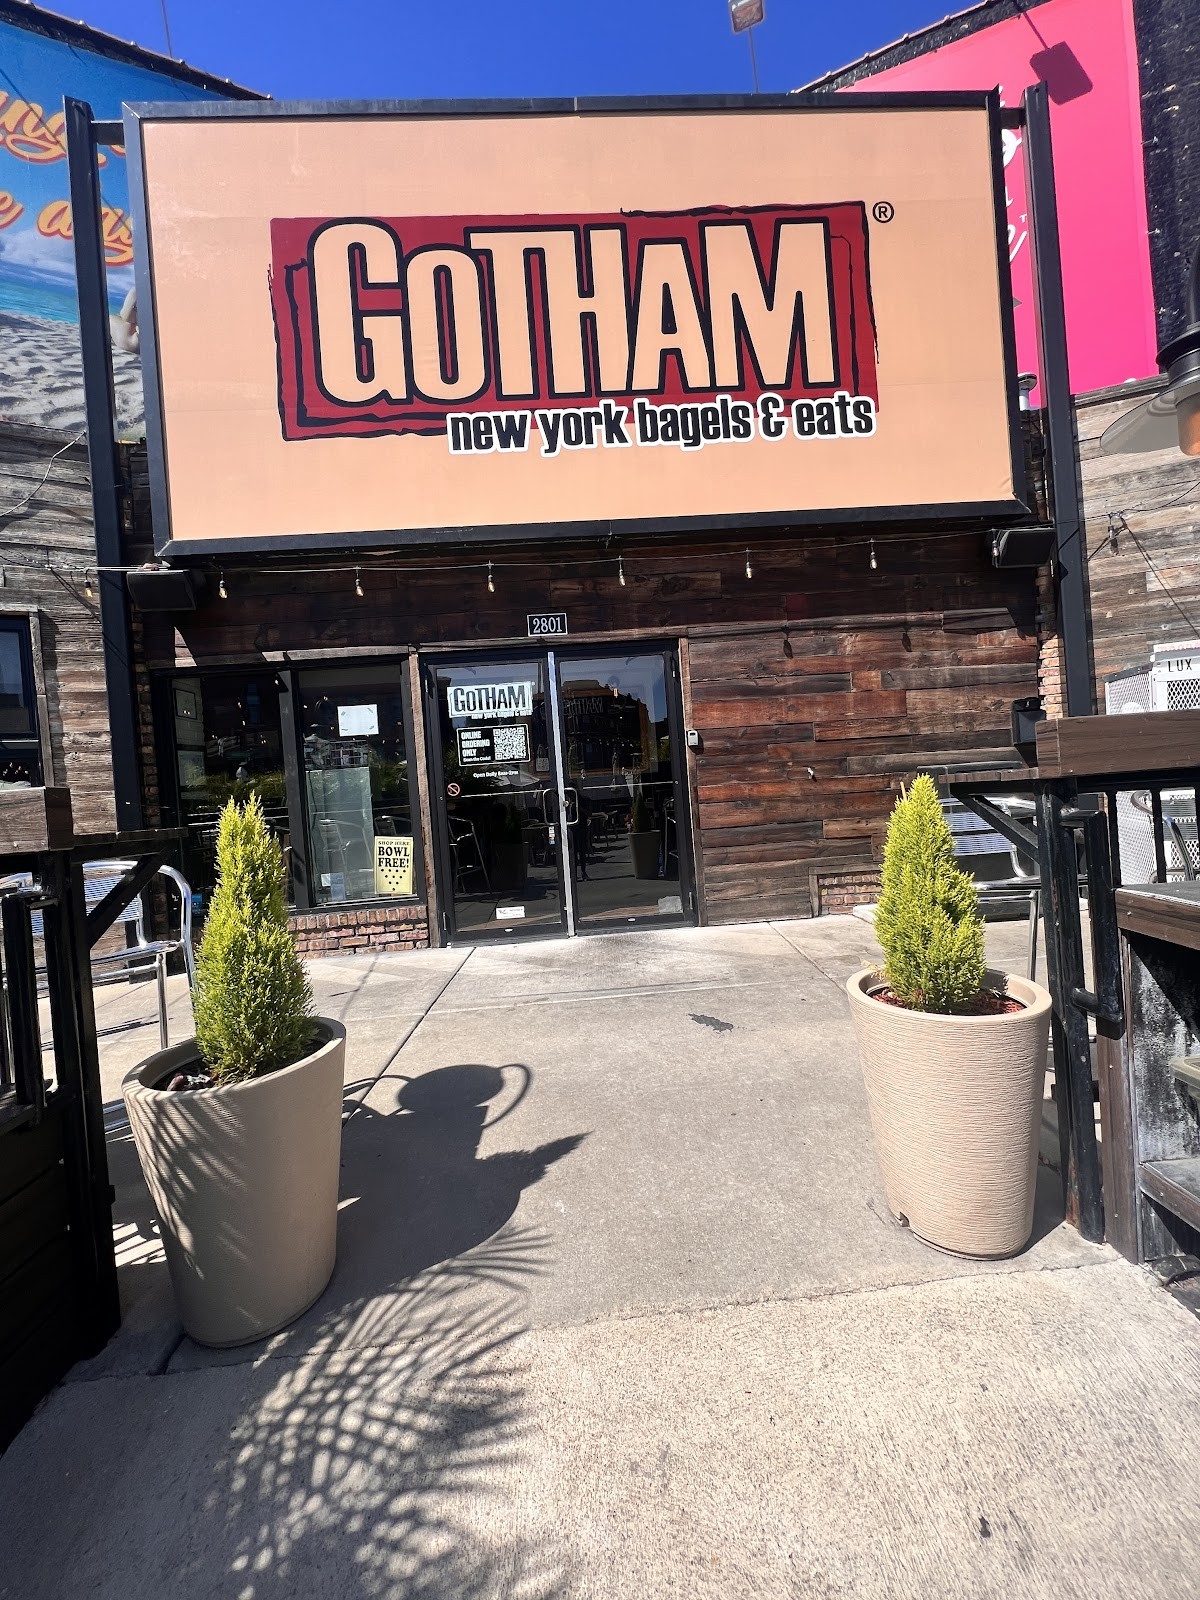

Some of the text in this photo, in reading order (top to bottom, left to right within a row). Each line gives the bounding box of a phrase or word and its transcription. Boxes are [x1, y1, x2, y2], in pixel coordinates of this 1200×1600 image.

[309, 219, 837, 404] GOTHAM
[450, 394, 873, 454] new york bagels & eats
[532, 616, 563, 634] 2801
[1167, 658, 1192, 672] LUX
[453, 685, 526, 712] GOTHAM
[461, 731, 481, 740] ONLINE
[461, 739, 490, 748] ORDERING
[462, 749, 477, 757] ONLY
[378, 846, 410, 857] BOWL
[378, 857, 409, 868] FREE!
